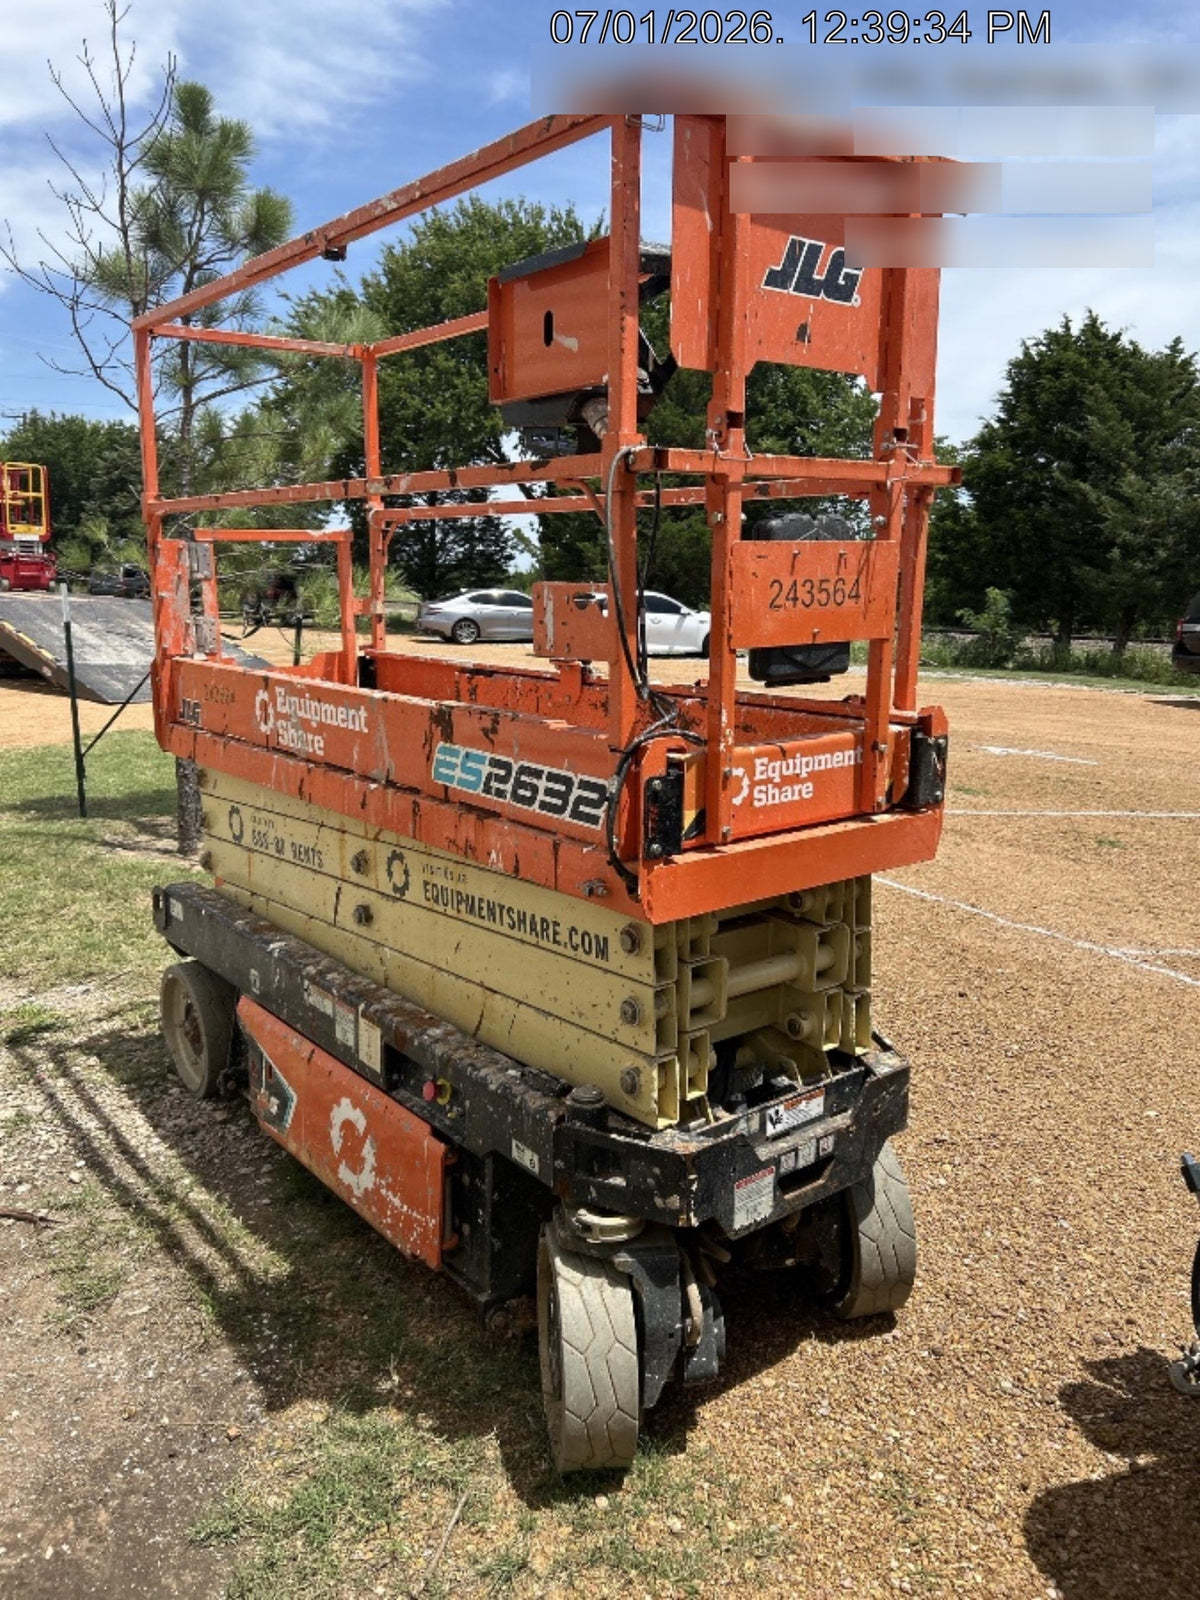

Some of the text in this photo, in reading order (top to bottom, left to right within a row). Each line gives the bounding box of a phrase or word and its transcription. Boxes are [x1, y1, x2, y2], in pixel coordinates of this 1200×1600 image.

[761, 235, 862, 305] JLG
[768, 577, 861, 611] 243564
[274, 685, 369, 734] Equipment
[276, 719, 325, 757] Share
[431, 741, 610, 831] ES2632
[753, 747, 864, 782] Equipment
[753, 782, 815, 808] Share
[421, 879, 610, 963] EQUIPMENTSHARE.COM
